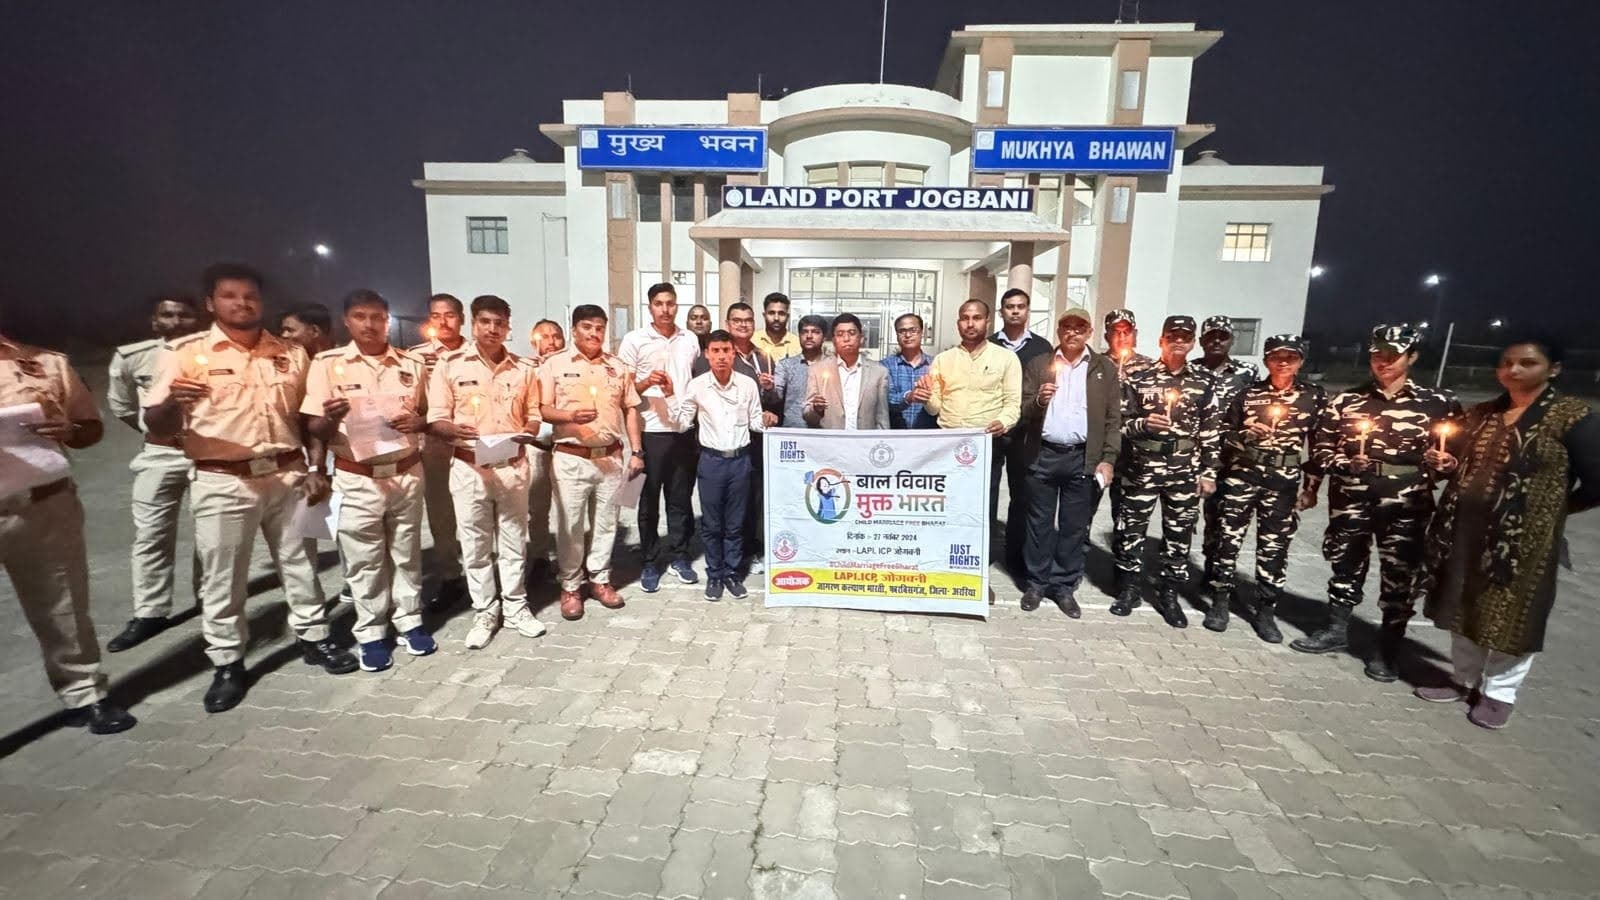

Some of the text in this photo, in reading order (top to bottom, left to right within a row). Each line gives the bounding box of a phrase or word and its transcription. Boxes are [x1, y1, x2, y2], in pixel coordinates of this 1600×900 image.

[607, 134, 758, 156] मुख्य भवन
[1001, 141, 1166, 160] MUKHYA BHAWAN
[745, 189, 1029, 209] LAND PORT JOGBANI
[780, 440, 797, 450] JUST
[780, 450, 806, 459] RIGHTS
[855, 470, 947, 492] बाल विवाह
[855, 494, 946, 518] मुक्त भारत
[873, 533, 881, 541] 27
[901, 533, 917, 541] 2024
[878, 547, 892, 555] ICP
[950, 544, 971, 554] JUST
[949, 555, 980, 566] RIGHTS
